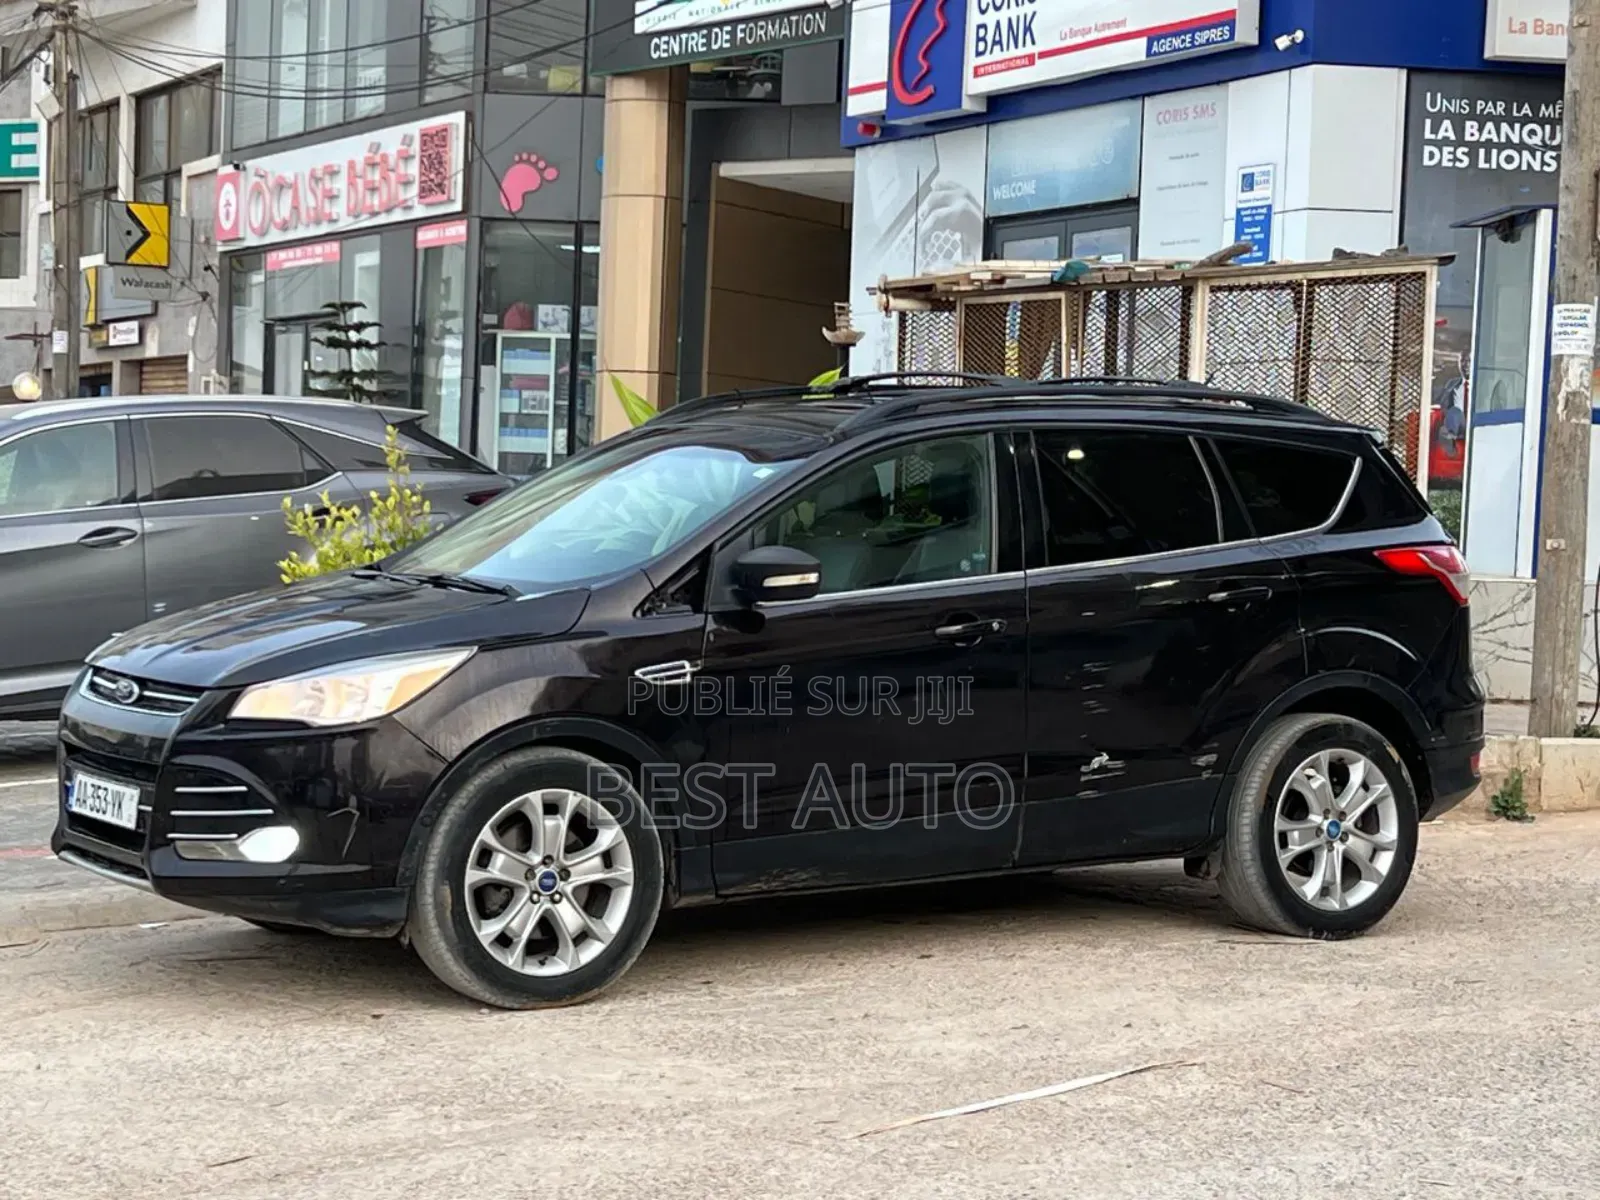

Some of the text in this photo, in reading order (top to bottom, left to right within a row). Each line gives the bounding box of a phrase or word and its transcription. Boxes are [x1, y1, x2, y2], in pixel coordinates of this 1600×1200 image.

[650, 11, 827, 59] CENTRE DE FORMATION
[975, 10, 1037, 58] BANK
[1507, 16, 1568, 36] La Ban
[1150, 25, 1231, 55] AGENCE SIPRES
[1156, 102, 1217, 125] CORIS SMS
[1476, 100, 1506, 116] PAR
[1513, 102, 1533, 117] LA
[1424, 118, 1456, 141] LA
[0, 123, 39, 177] E
[1423, 145, 1558, 172] DES LIONS
[347, 134, 414, 218] BÉBÉ
[993, 180, 1037, 200] WELCOME
